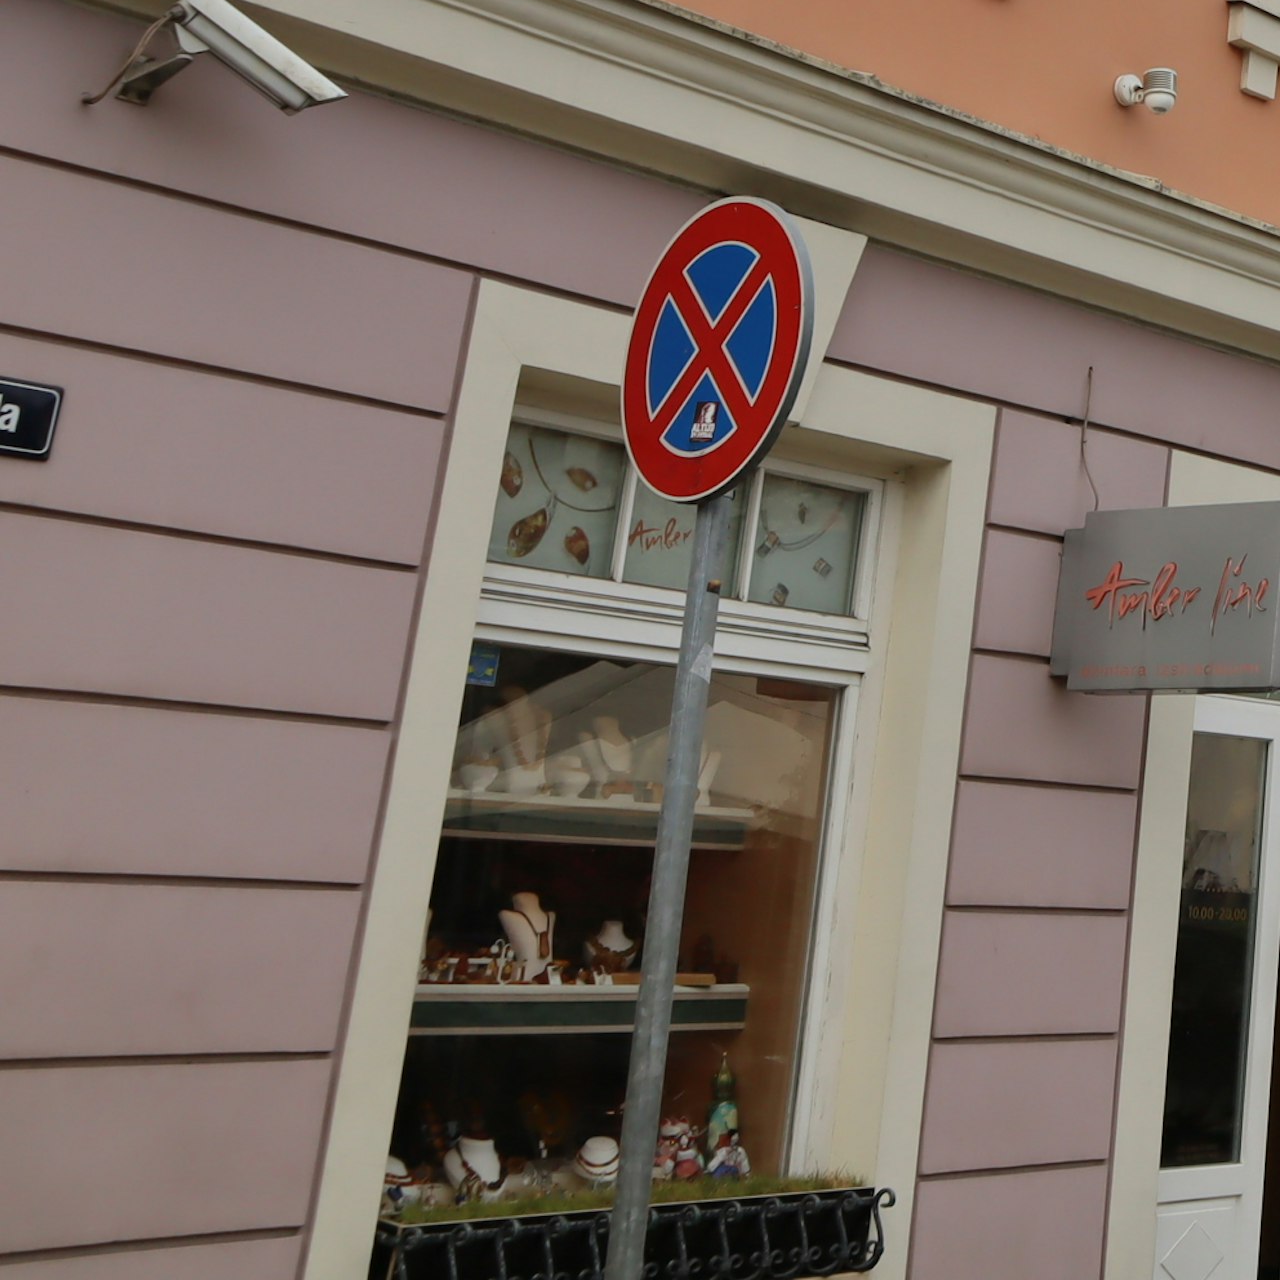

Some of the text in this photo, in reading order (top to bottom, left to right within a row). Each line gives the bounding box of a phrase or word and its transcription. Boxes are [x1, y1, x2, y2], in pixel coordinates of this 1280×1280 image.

[0, 393, 20, 433] a
[629, 517, 692, 553] Amber
[1086, 553, 1269, 637] Amber line
